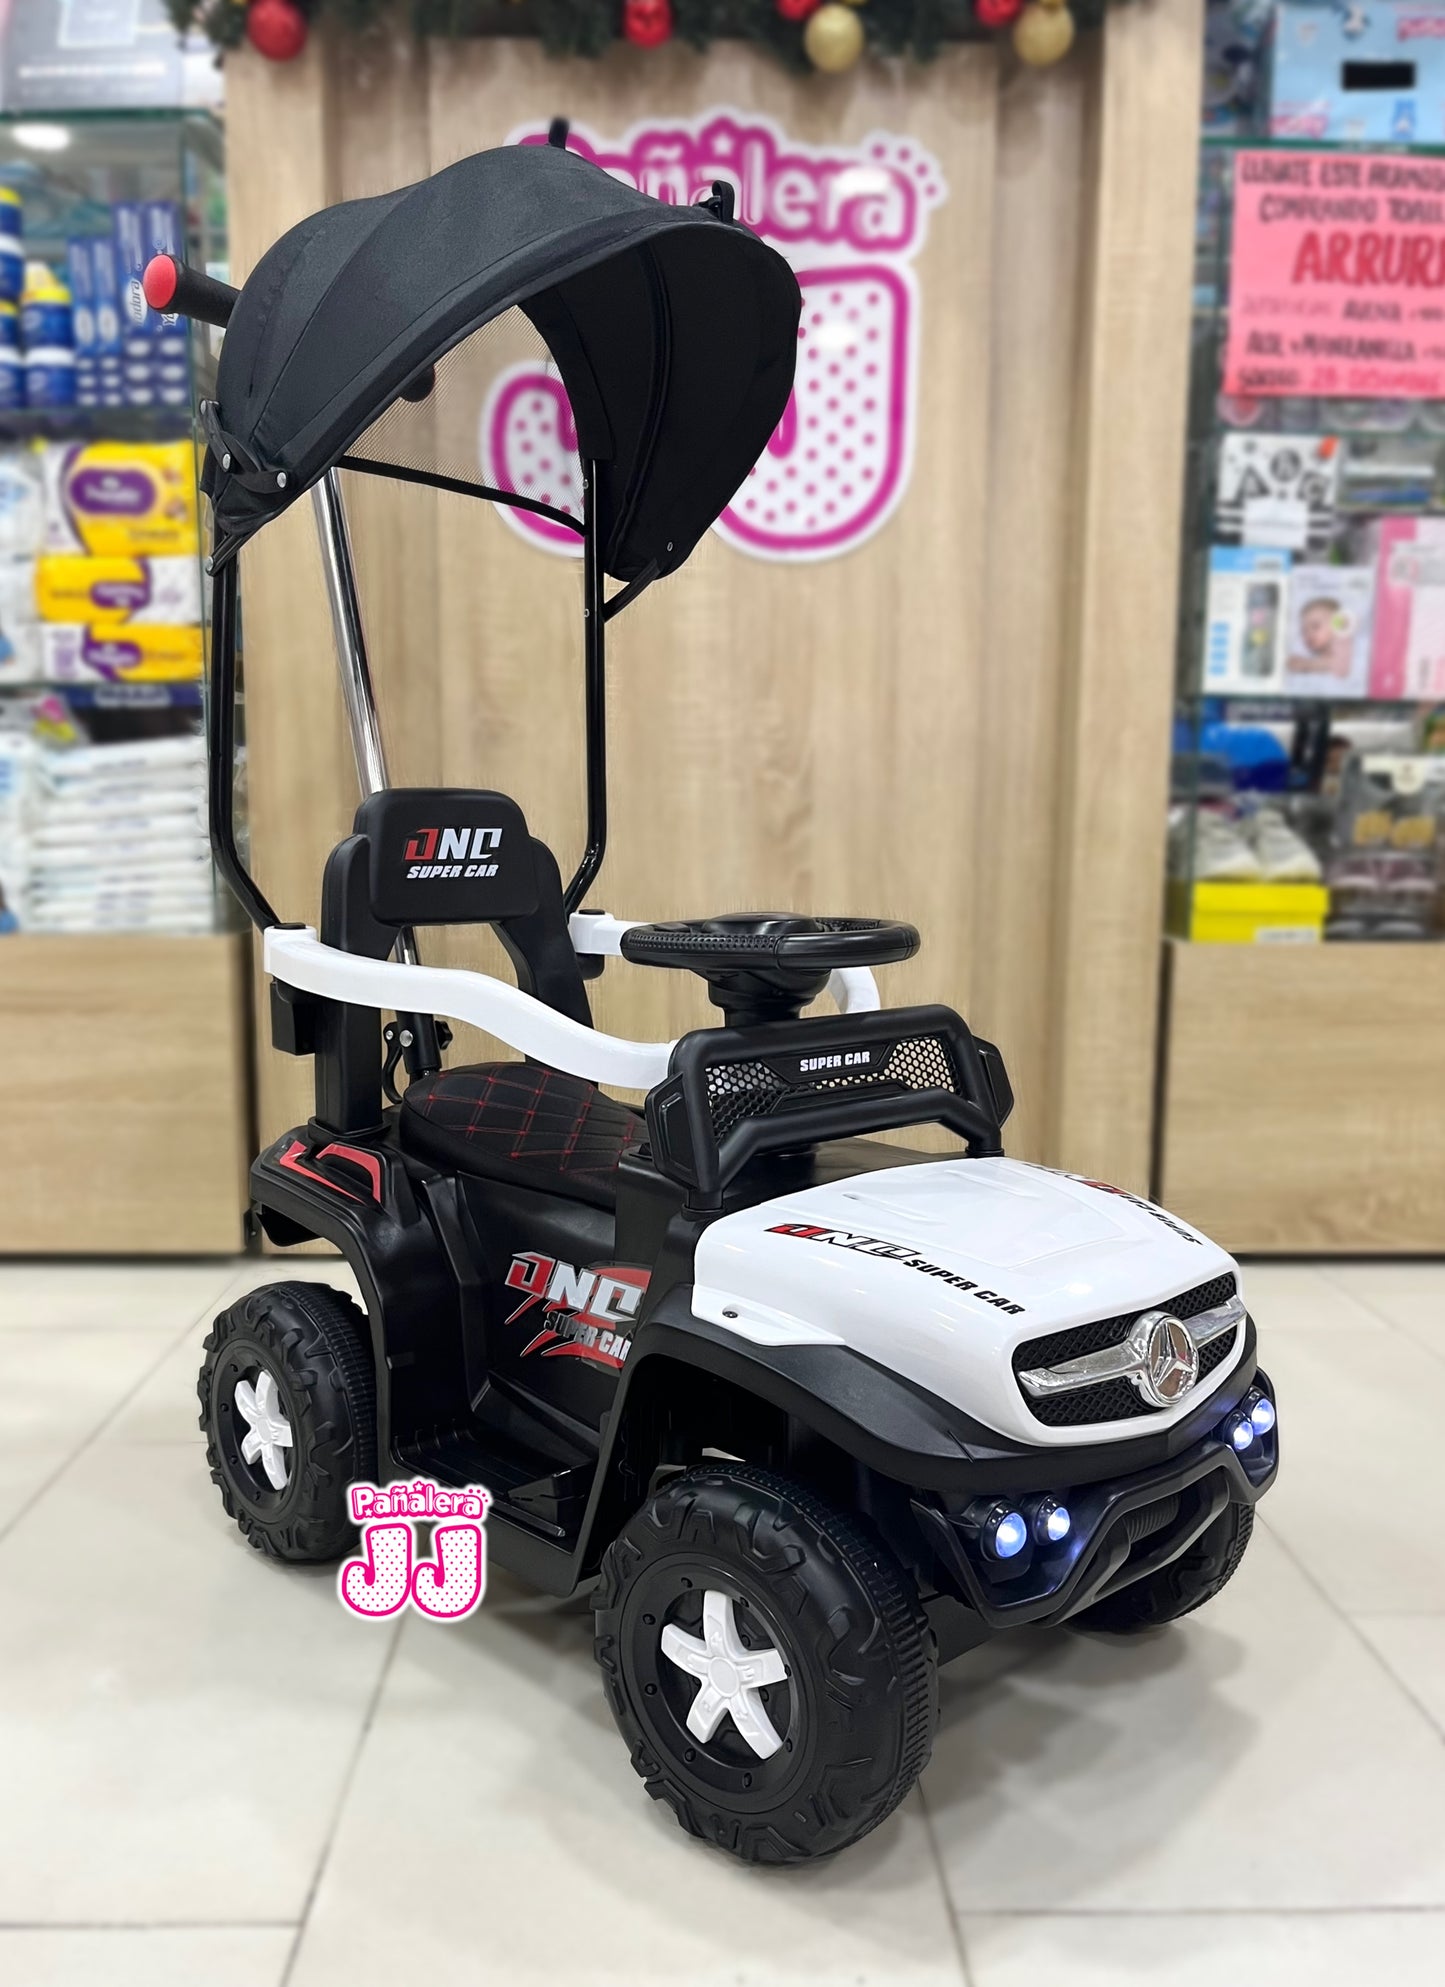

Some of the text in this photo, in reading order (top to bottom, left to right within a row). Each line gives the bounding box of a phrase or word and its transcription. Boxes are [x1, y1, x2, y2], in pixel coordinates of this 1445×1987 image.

[406, 864, 499, 879] SUPER CAR
[800, 1051, 871, 1072] SUPER CAR
[903, 1258, 980, 1291] SUPER
[973, 1289, 1026, 1316] CAR
[543, 1311, 599, 1348] SUPER
